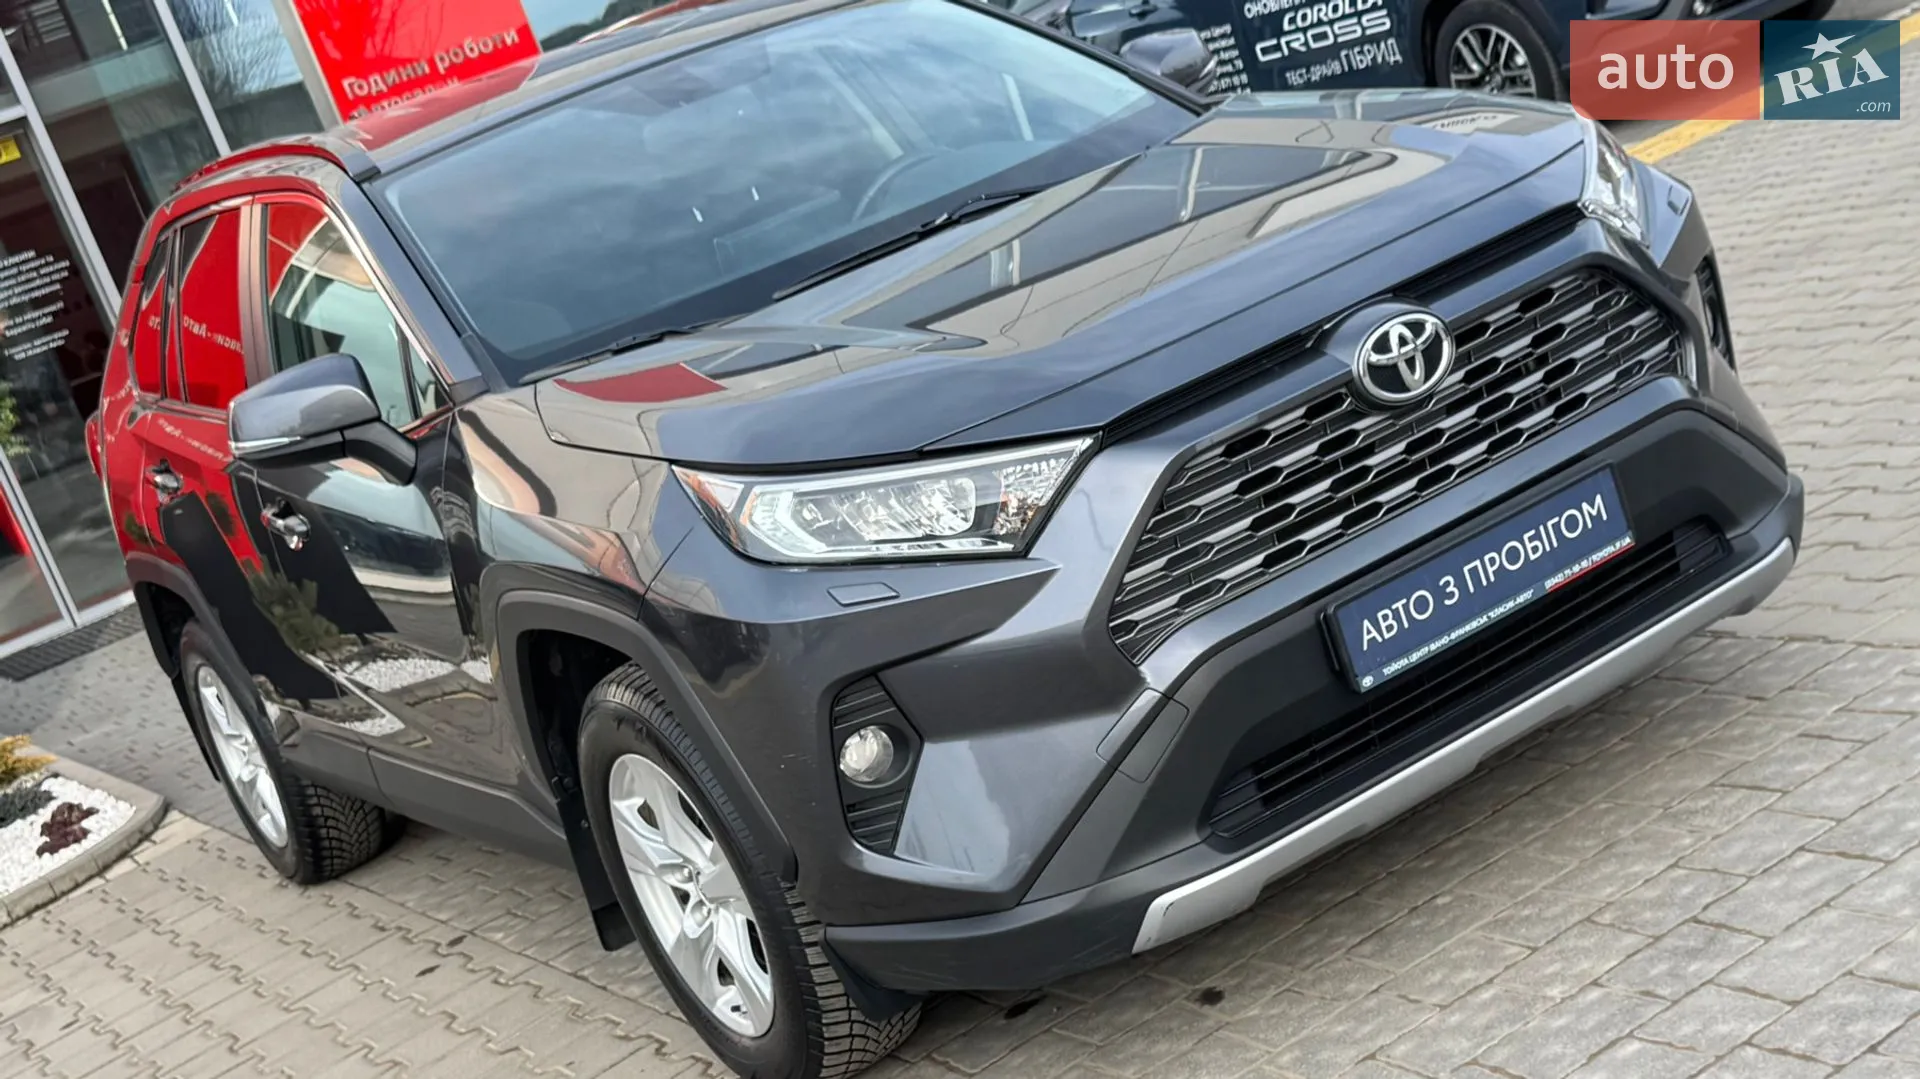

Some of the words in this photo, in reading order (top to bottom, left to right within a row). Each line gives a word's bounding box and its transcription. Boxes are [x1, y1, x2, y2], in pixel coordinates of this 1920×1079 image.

[1255, 9, 1391, 62] CROSS
[1283, 0, 1383, 31] COROLLA
[341, 58, 430, 100] Години
[434, 28, 520, 74] роботи
[1285, 57, 1342, 86] ТЕСТ-ДРАЙВ
[1340, 37, 1402, 72] ГІБРИД
[1362, 589, 1434, 651] АВТО
[1439, 575, 1459, 605] З
[1463, 493, 1608, 593] ПРОБІГОМ
